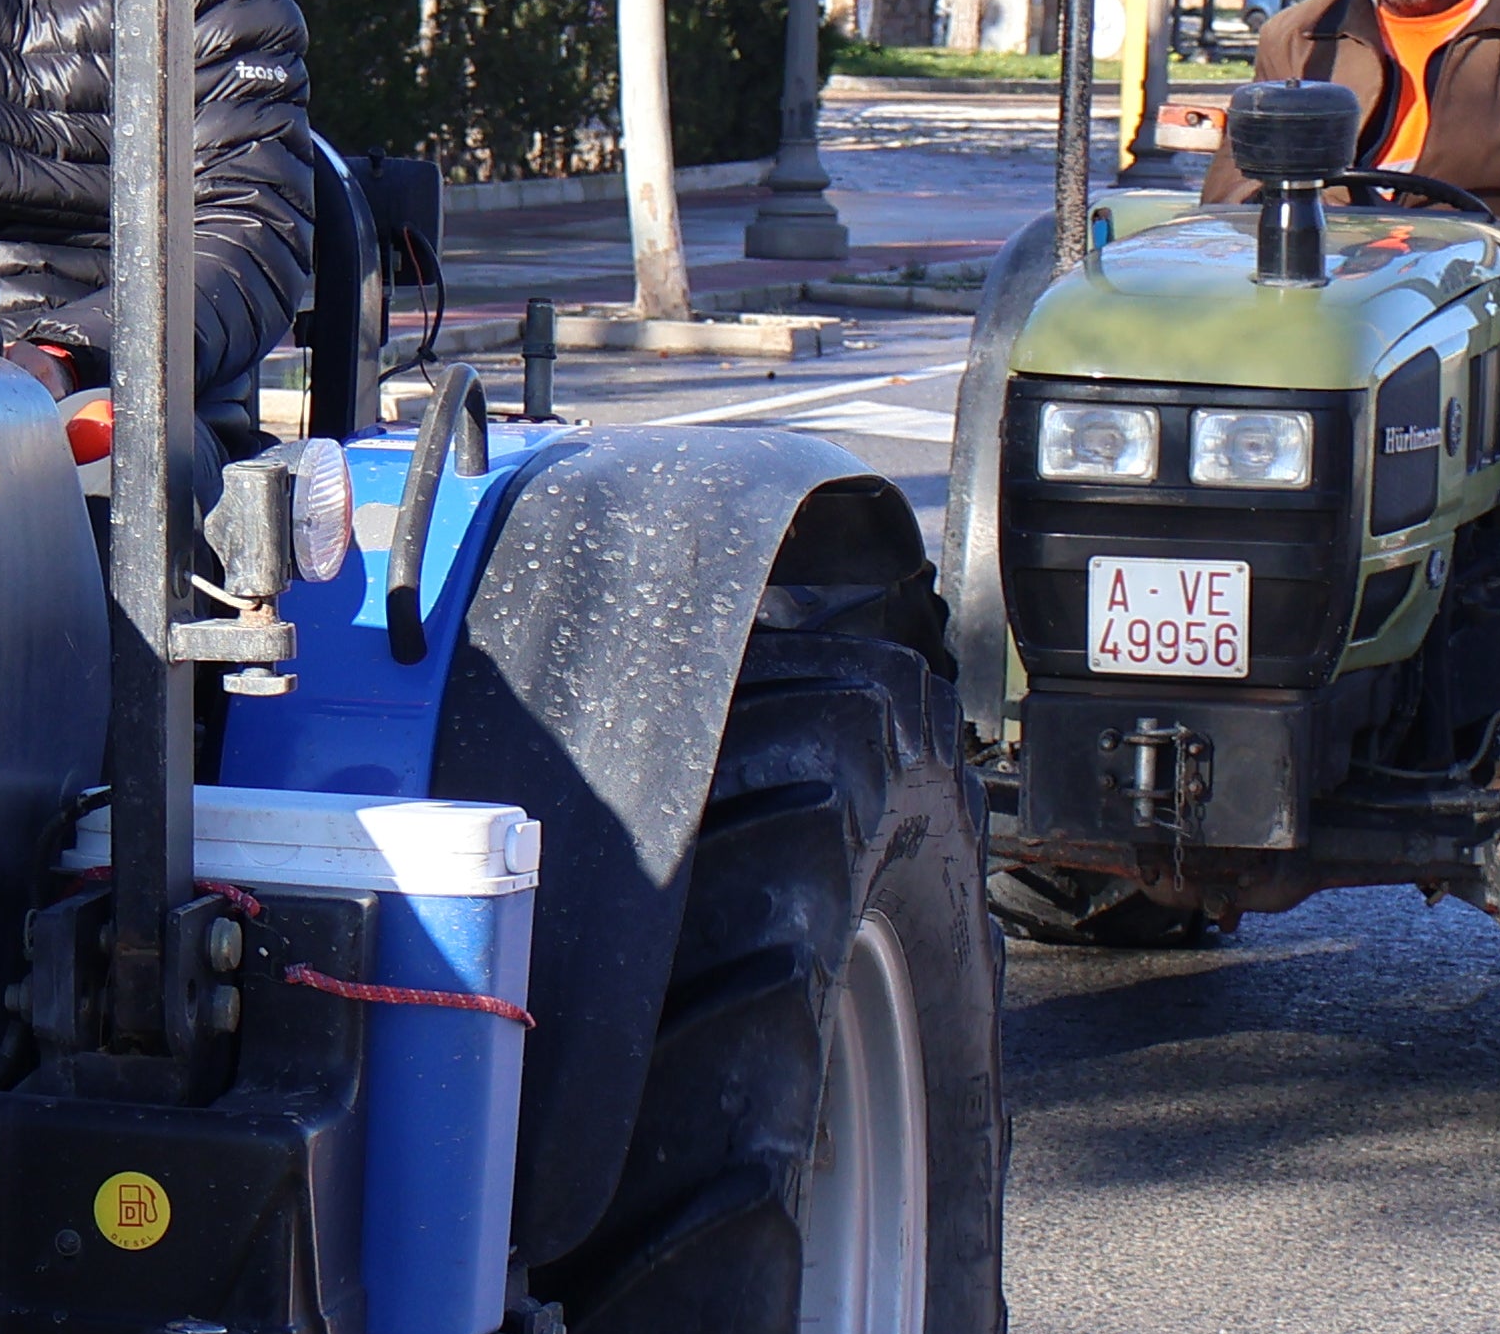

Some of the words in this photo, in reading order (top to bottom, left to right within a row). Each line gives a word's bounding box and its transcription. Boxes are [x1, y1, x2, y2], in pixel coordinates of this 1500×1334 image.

[1107, 568, 1129, 613] A
[1179, 570, 1232, 616] VE
[1099, 617, 1239, 667] 49956
[111, 1233, 154, 1247] DIESEL
